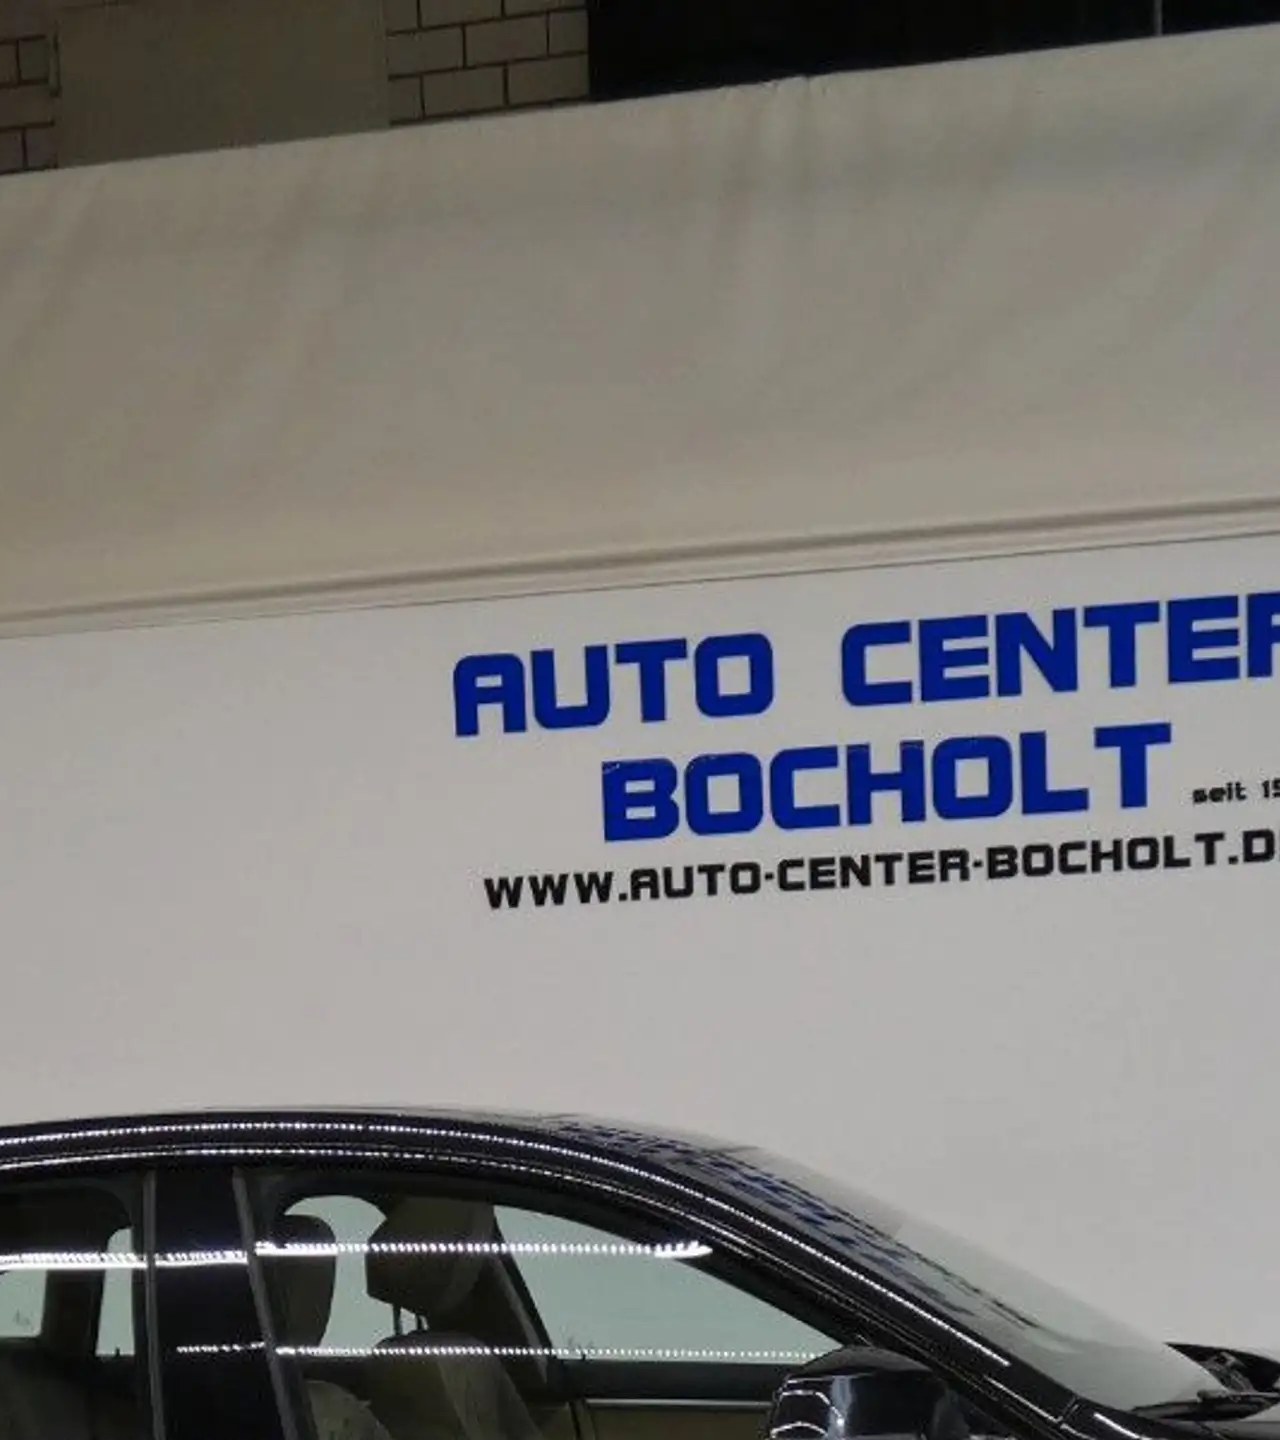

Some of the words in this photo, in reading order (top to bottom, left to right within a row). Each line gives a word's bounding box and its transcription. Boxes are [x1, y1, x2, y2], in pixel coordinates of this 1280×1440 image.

[453, 633, 776, 738] AUTO
[602, 721, 1172, 842] BOCHOLT
[1191, 780, 1248, 805] seit
